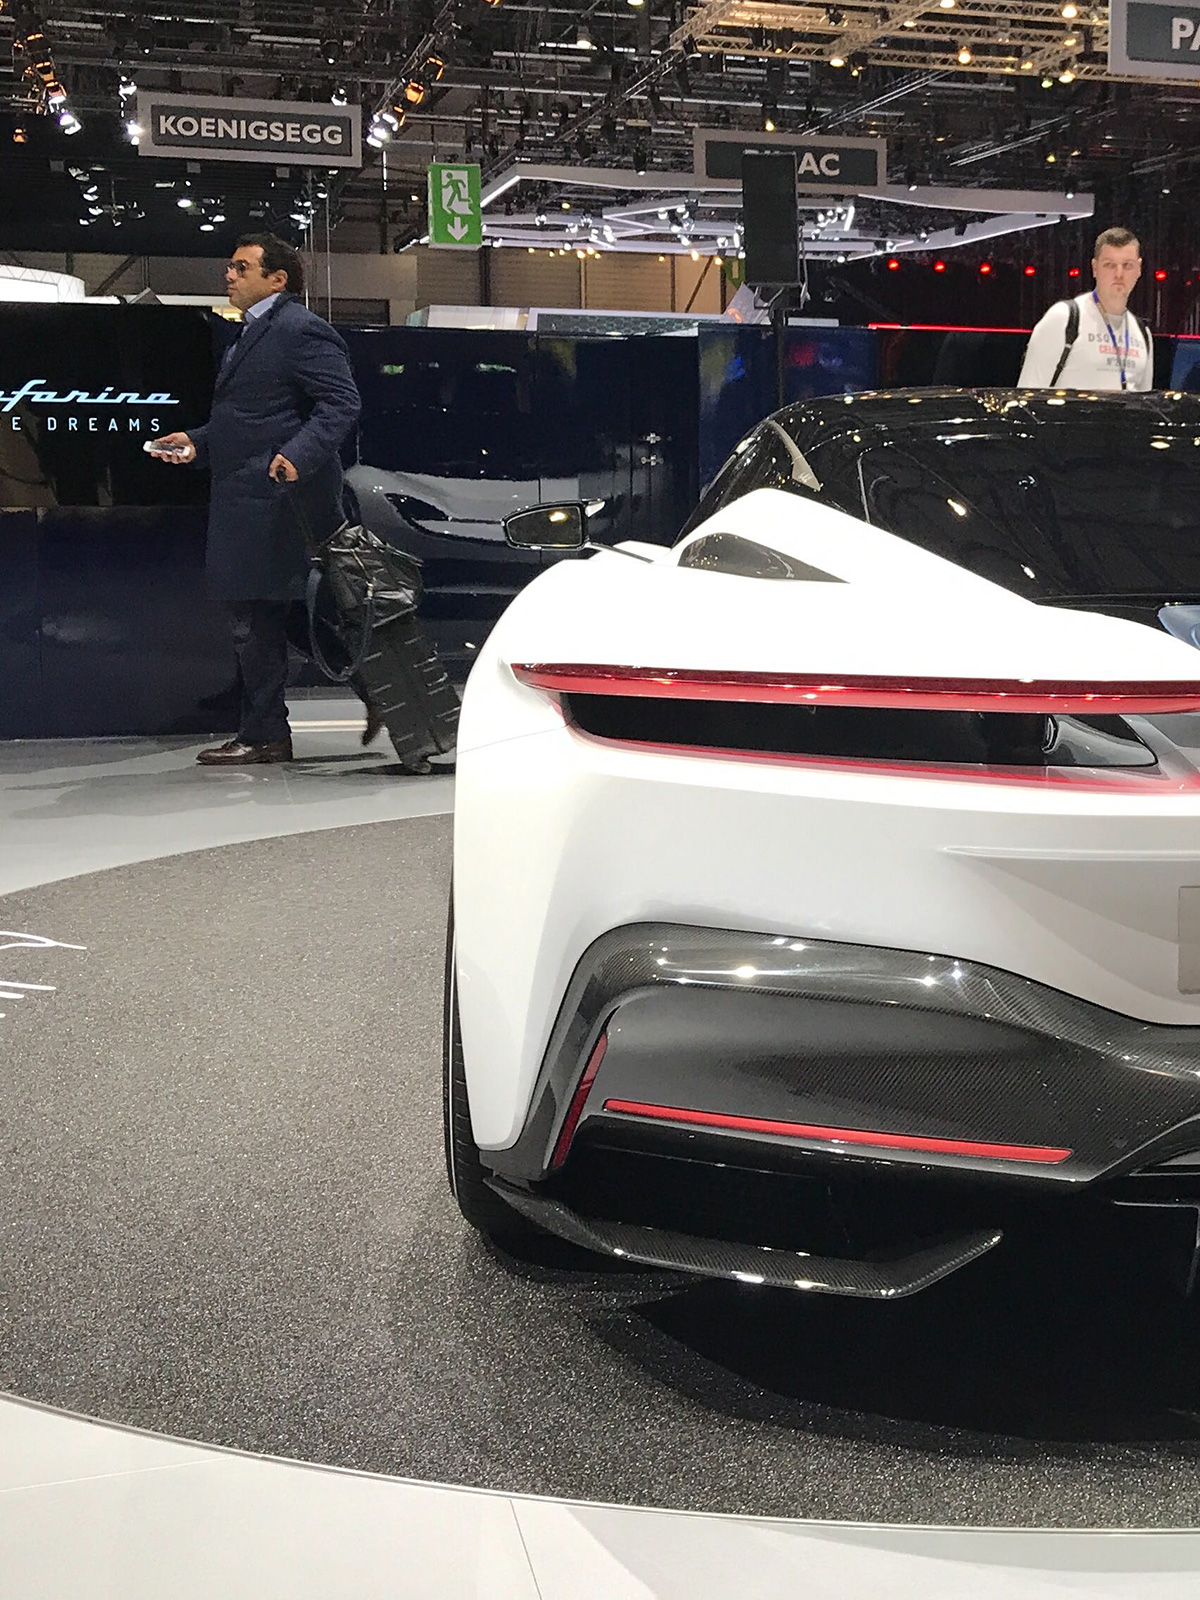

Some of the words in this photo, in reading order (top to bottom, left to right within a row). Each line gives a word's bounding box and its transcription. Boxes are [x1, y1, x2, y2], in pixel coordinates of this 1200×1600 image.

[159, 115, 343, 145] KOENIGSEGG
[0, 379, 180, 412] farina
[47, 416, 161, 432] DREAMS
